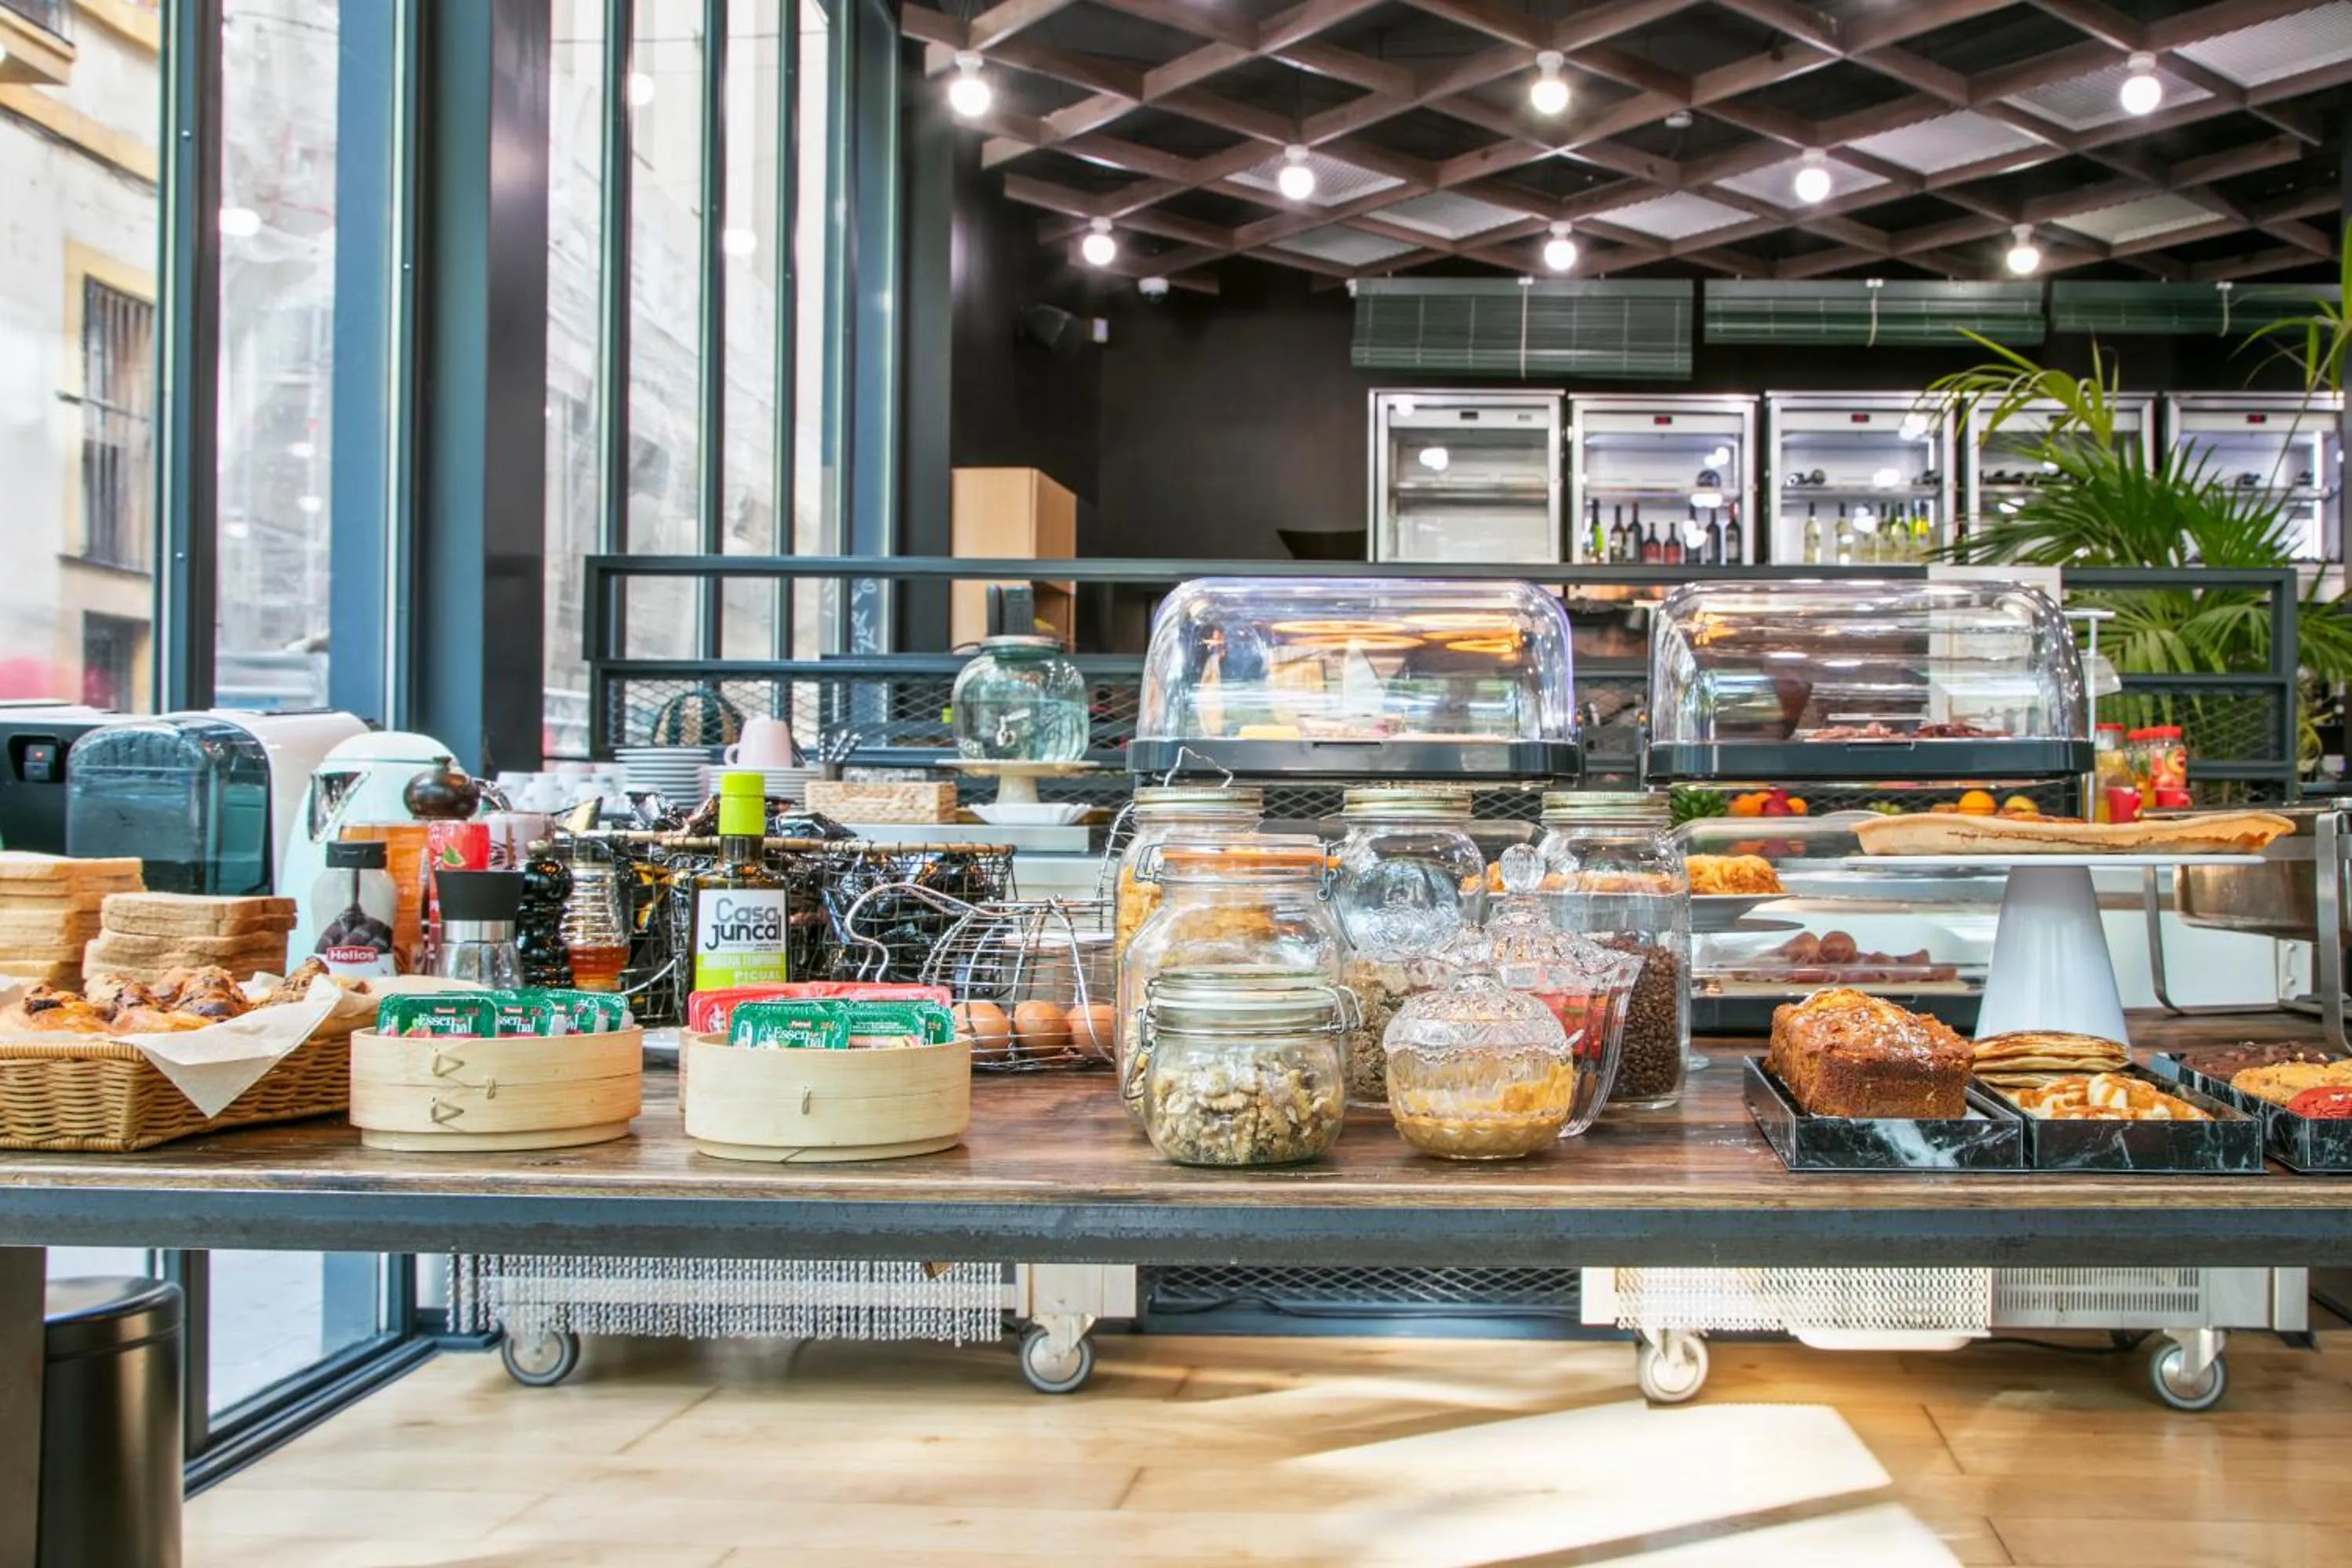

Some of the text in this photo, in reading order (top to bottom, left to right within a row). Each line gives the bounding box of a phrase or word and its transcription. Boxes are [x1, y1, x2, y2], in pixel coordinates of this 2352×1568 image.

[716, 897, 779, 924] Casa
[705, 915, 782, 950] juncal
[330, 949, 376, 960] Helios
[735, 970, 782, 982] PICUAL
